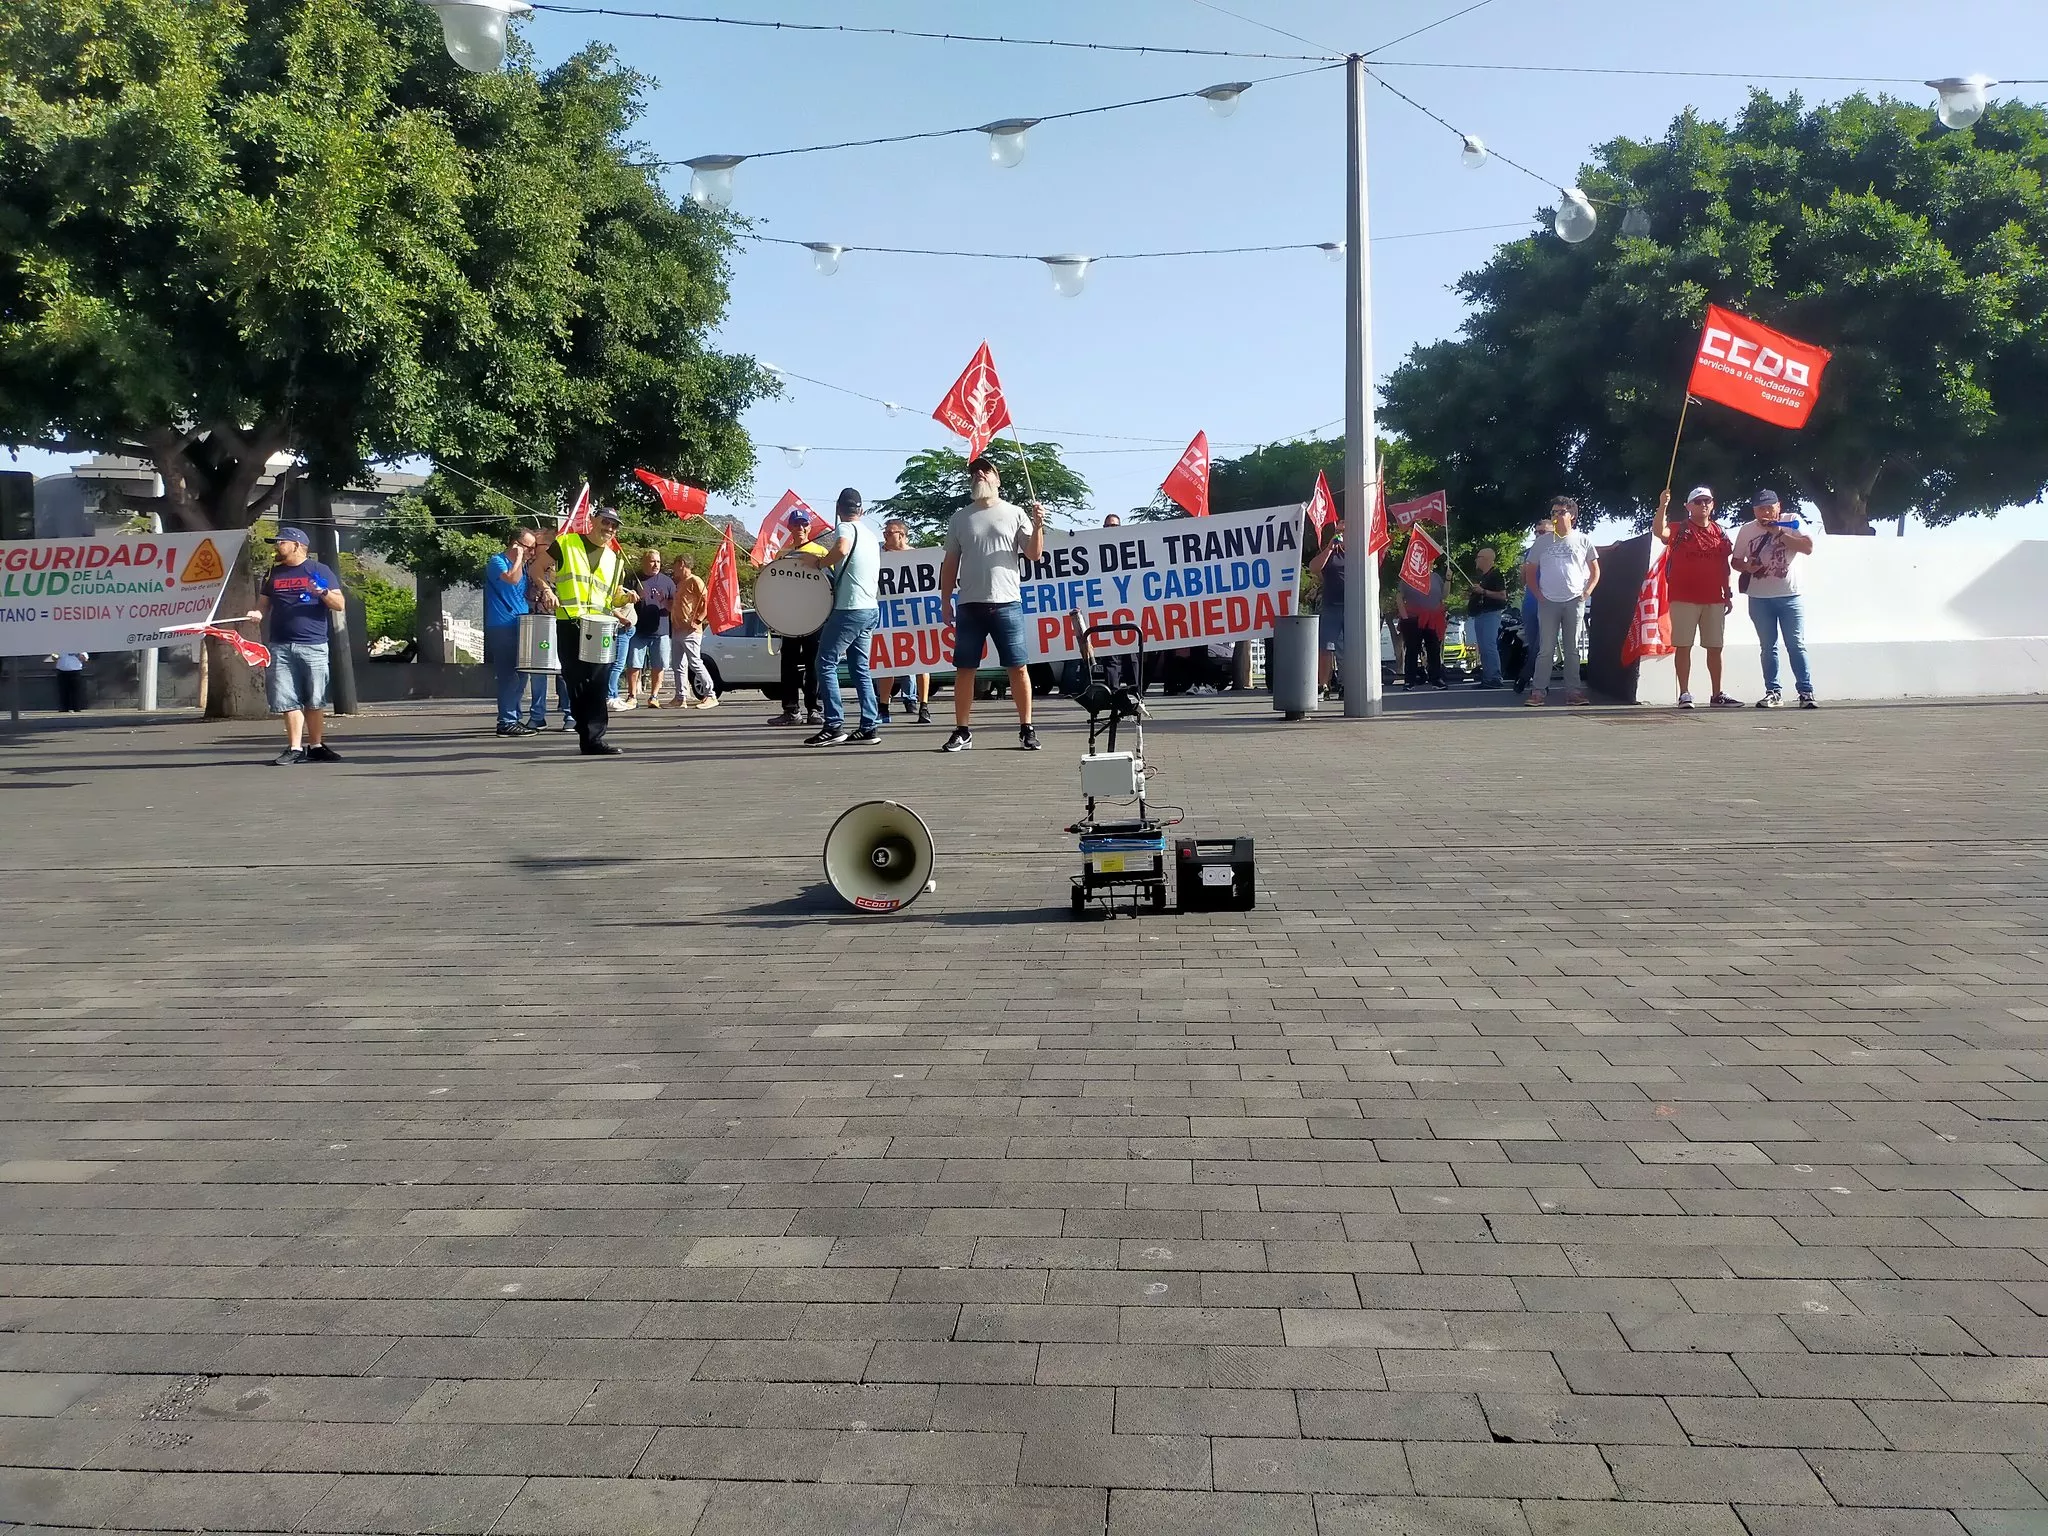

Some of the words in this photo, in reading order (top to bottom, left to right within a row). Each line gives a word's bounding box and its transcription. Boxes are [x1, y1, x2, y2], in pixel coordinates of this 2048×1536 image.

[1702, 327, 1810, 387] CCOO
[1699, 357, 1735, 376] servicios
[1737, 369, 1743, 378] a
[1744, 371, 1753, 381] la
[1754, 375, 1806, 398] ciudadanía
[1761, 390, 1801, 409] canarias
[1099, 540, 1155, 573] DEL
[0, 572, 70, 598] LUD
[73, 571, 92, 581] DE
[96, 570, 113, 580] LA
[278, 579, 302, 587] FILA
[770, 568, 820, 580] gonalca
[1112, 574, 1132, 604] Y
[1143, 558, 1271, 601] CABILDO
[71, 580, 164, 595] CIUDADANÍA
[53, 606, 111, 621] DESIDIA
[116, 605, 125, 619] Y
[129, 595, 215, 618] CORRUPCIÓN
